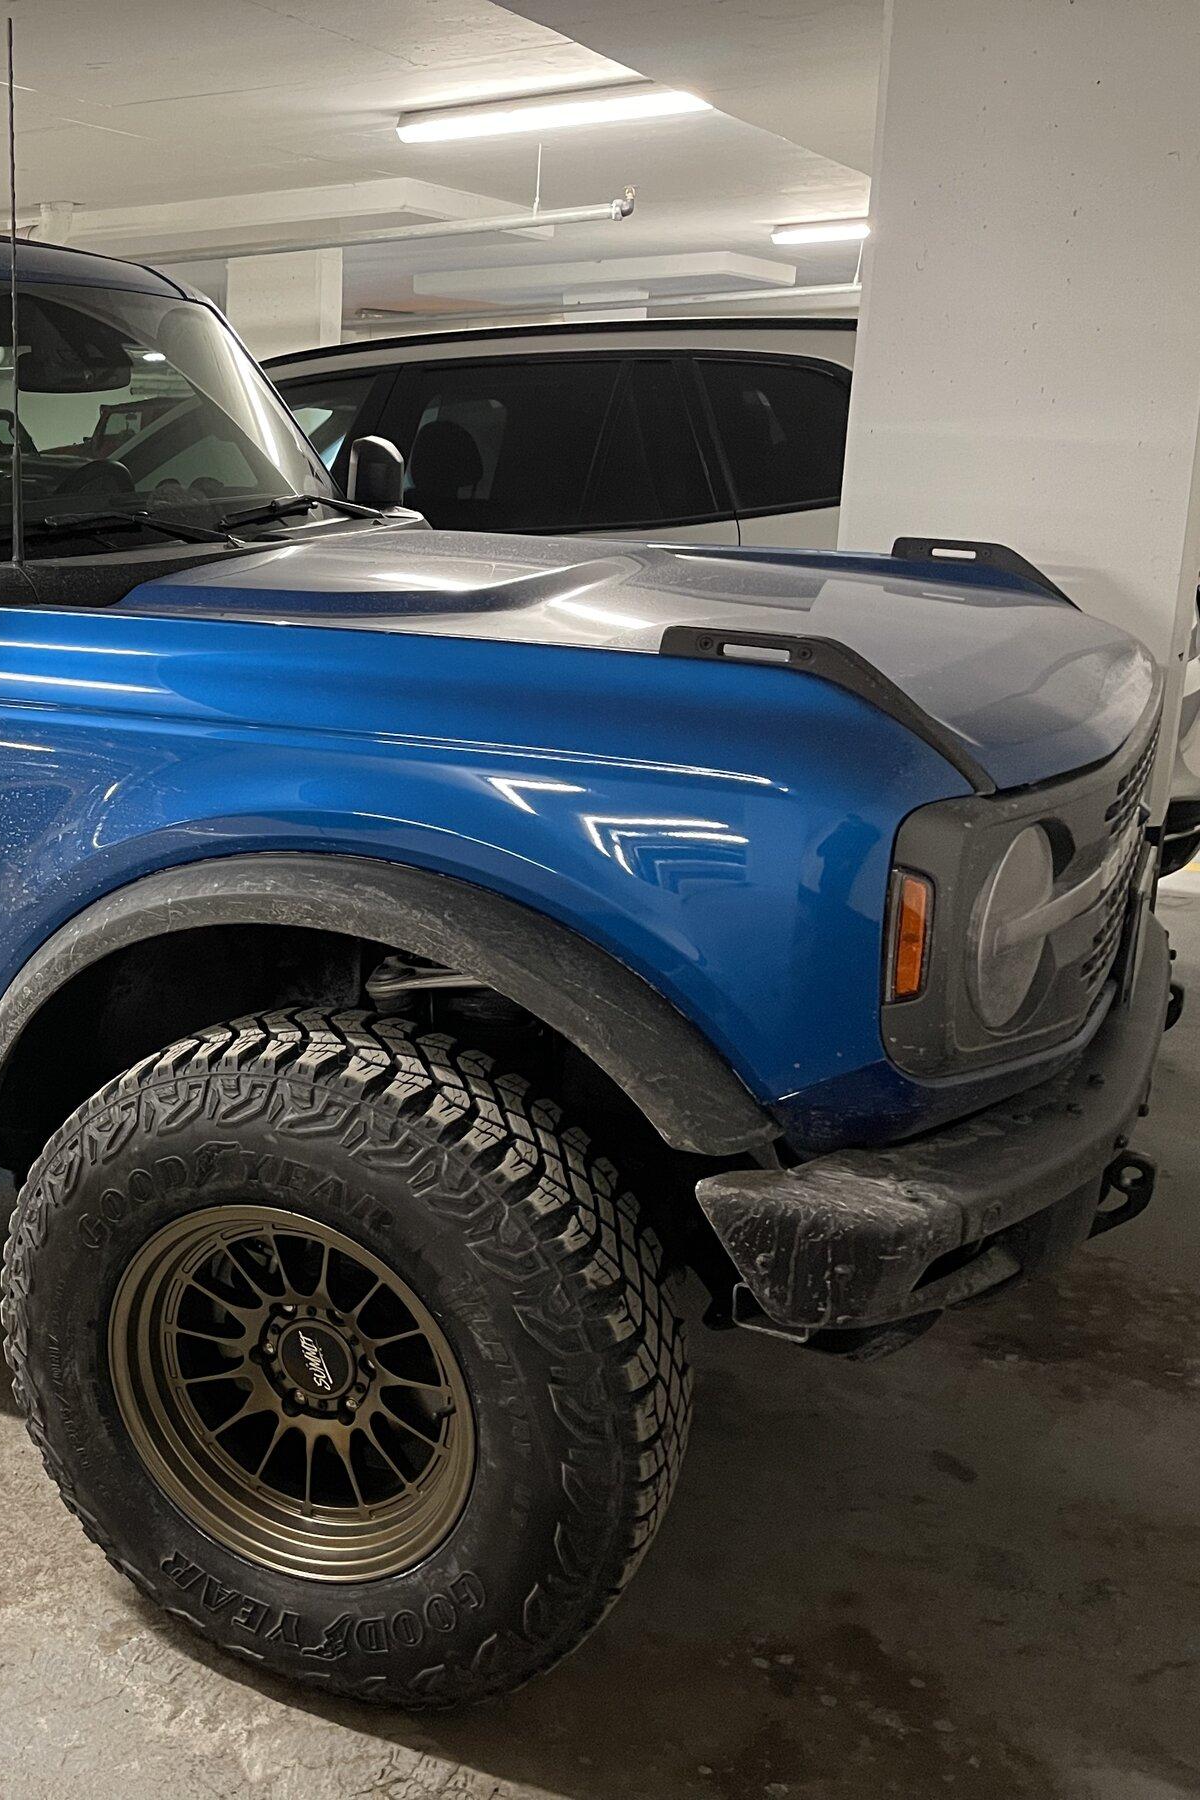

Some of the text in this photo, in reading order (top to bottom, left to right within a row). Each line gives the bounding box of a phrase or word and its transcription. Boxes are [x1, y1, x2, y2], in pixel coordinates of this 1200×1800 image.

[77, 1143, 394, 1249] GOODYEAR
[298, 1330, 332, 1391] SUMMIT
[160, 1550, 486, 1660] GOODYEAR
